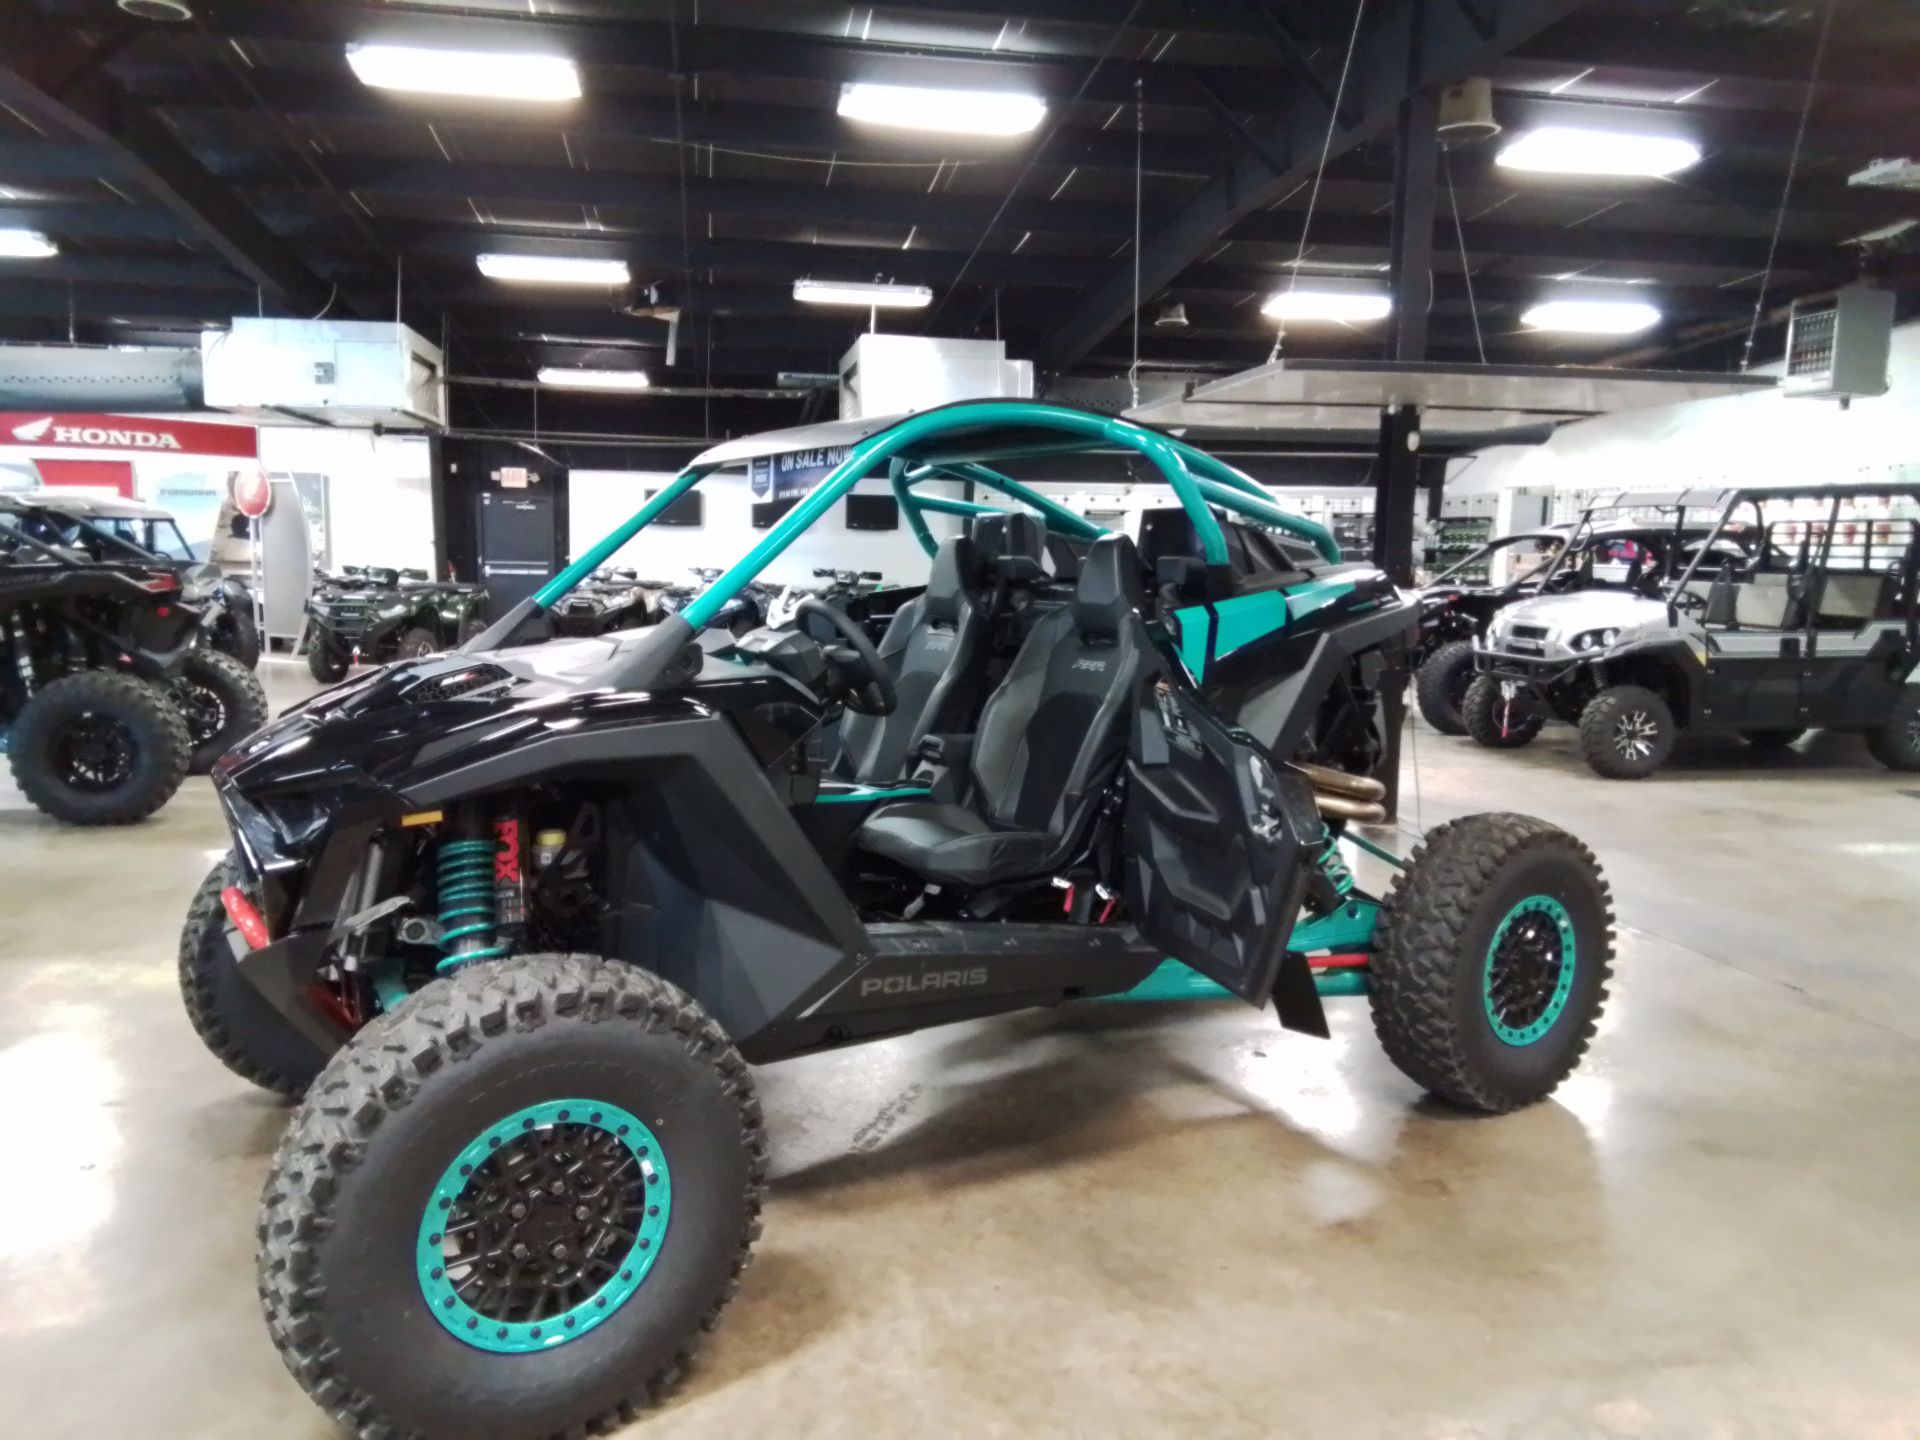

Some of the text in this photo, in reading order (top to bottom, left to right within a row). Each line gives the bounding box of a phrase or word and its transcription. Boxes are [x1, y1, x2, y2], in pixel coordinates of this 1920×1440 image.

[53, 427, 182, 449] HONDA
[781, 453, 794, 472] ON
[795, 448, 824, 470] SALE
[495, 817, 519, 884] FOX
[860, 966, 988, 997] POLARIS
